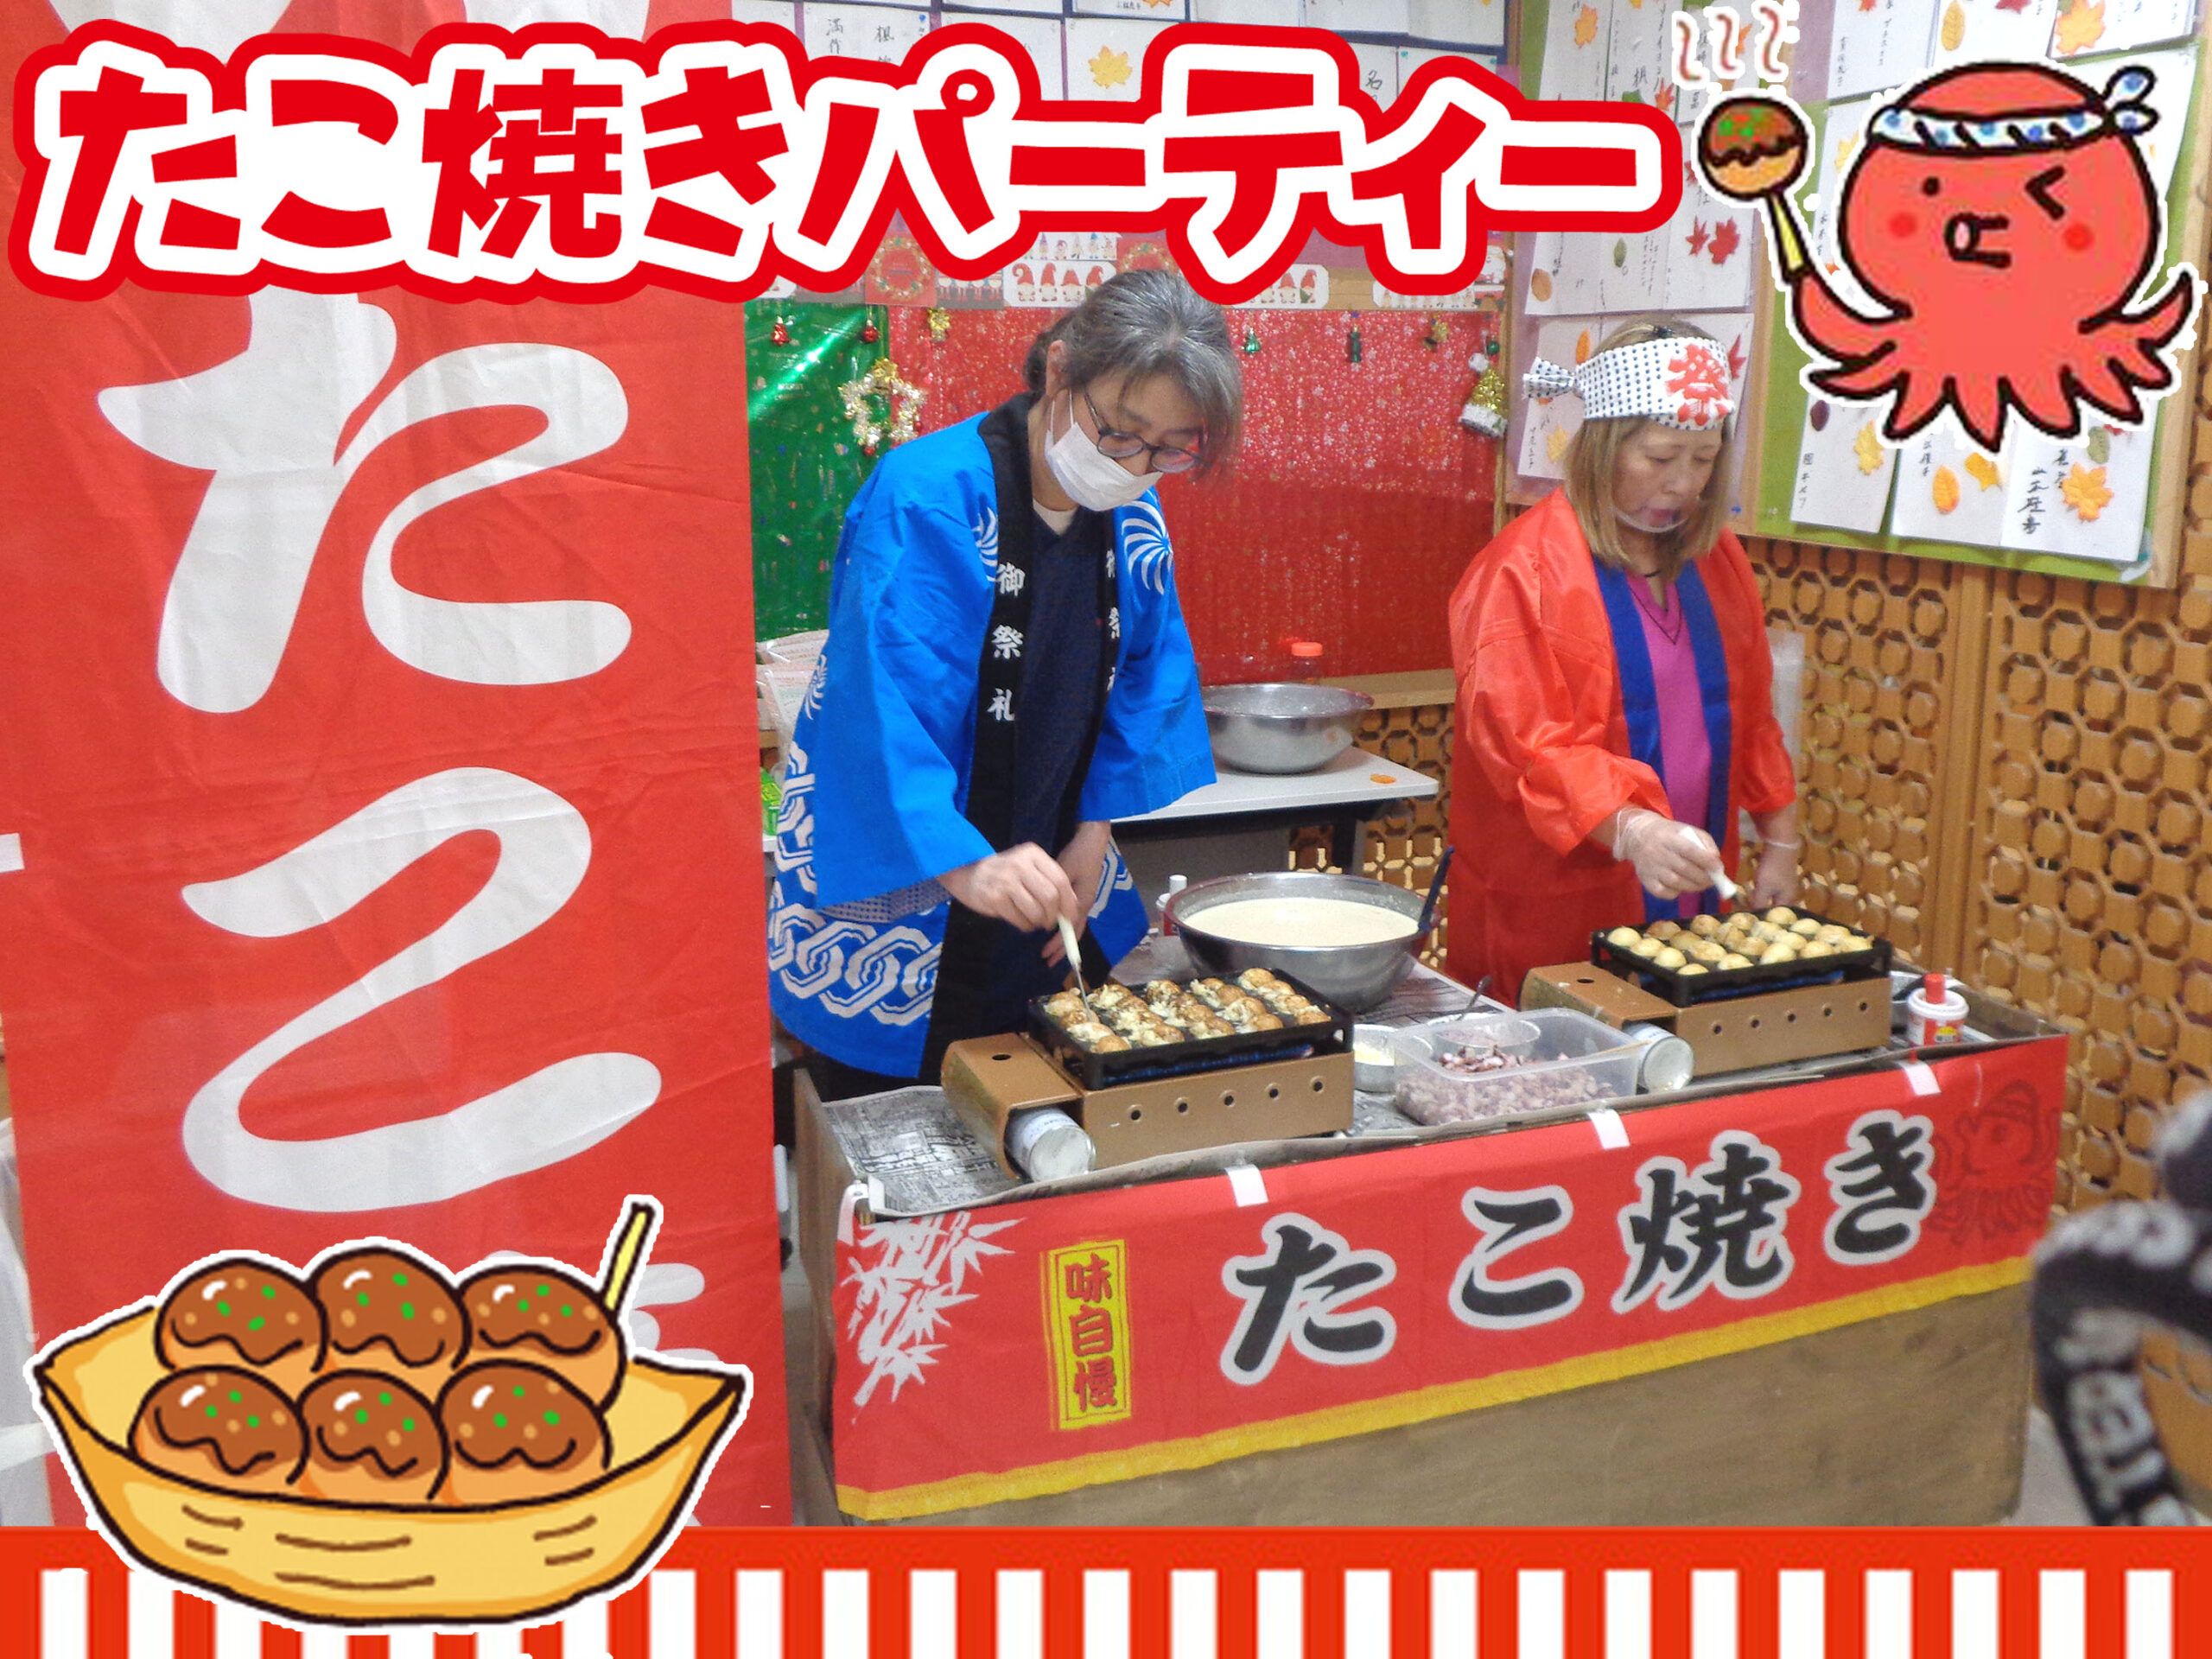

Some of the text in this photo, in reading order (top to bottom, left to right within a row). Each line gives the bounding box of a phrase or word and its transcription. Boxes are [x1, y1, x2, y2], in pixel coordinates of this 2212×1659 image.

[987, 562, 1027, 722] 御祭礼
[1220, 1110, 1937, 1386] たこ焼き
[1065, 1252, 1117, 1412] 味自慢
